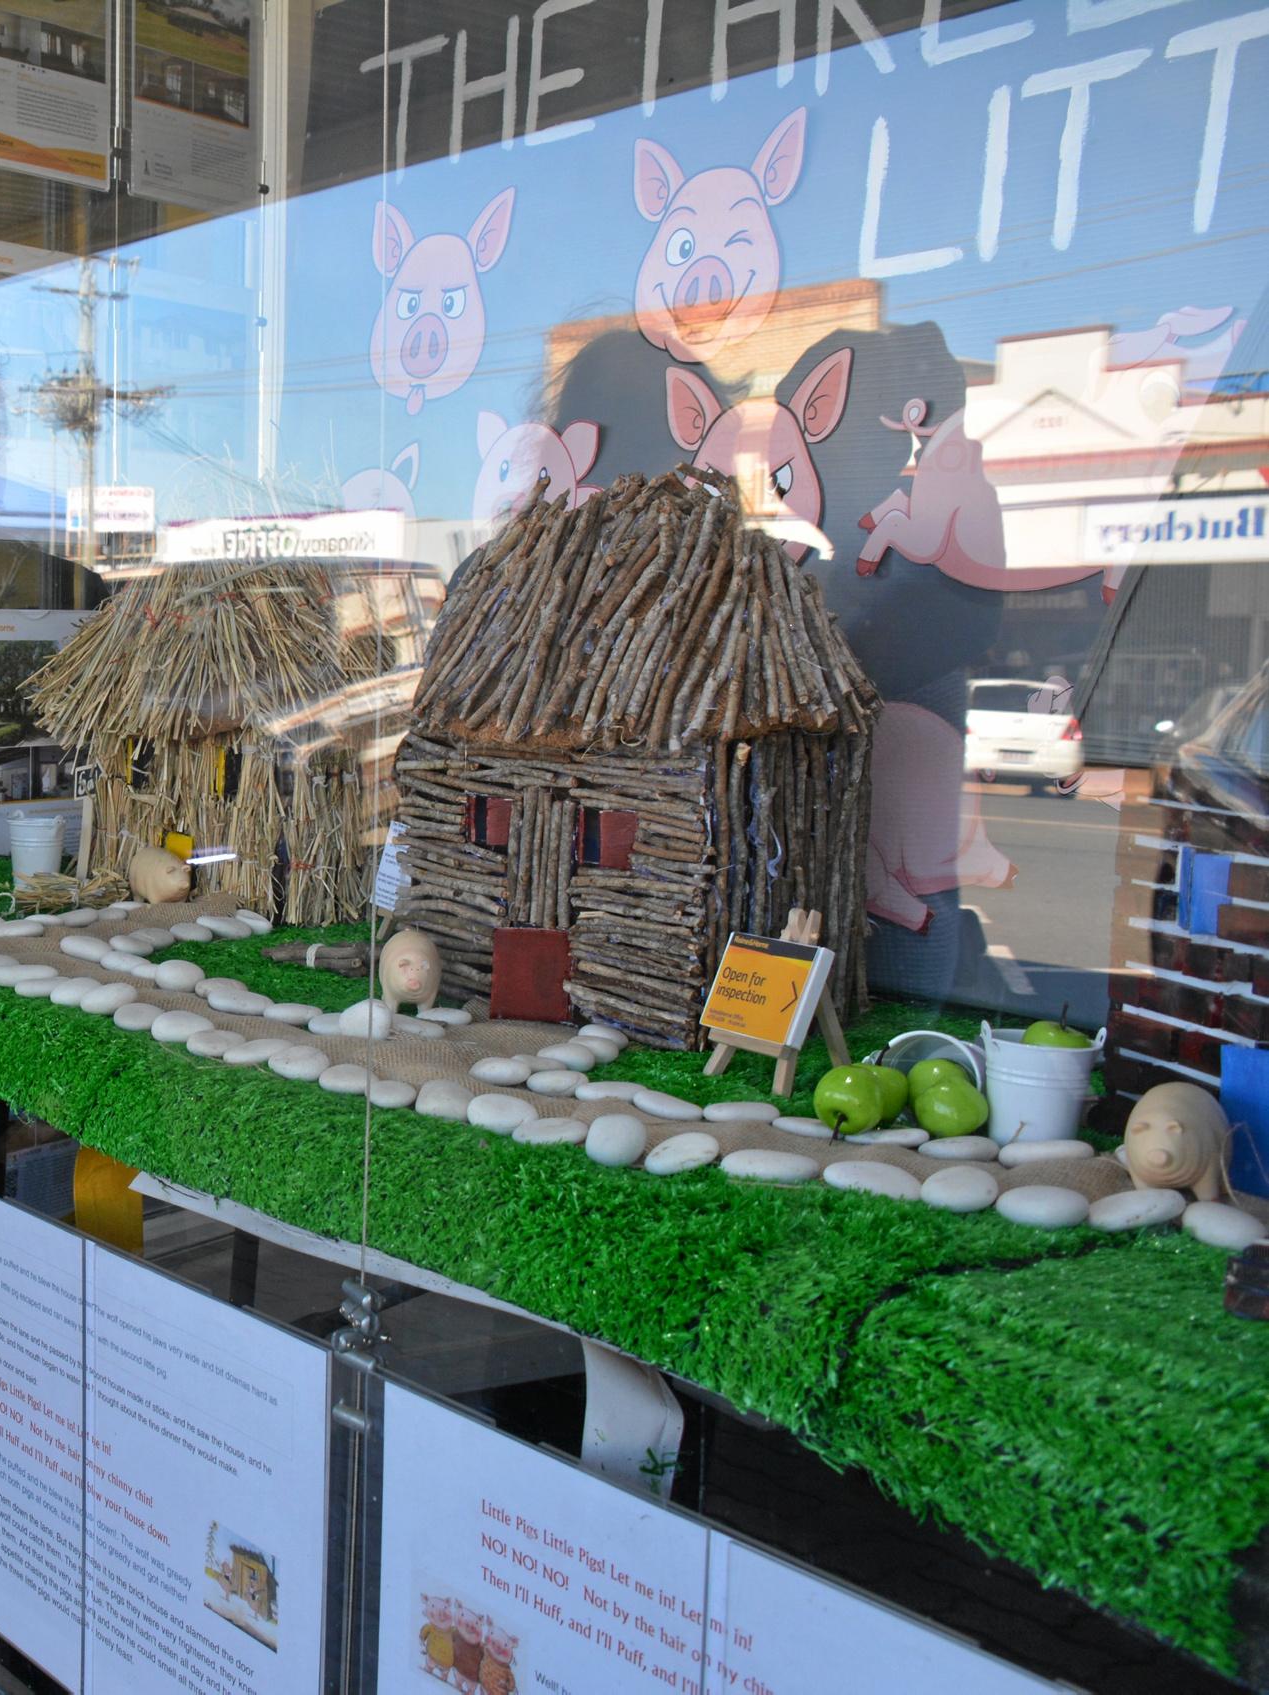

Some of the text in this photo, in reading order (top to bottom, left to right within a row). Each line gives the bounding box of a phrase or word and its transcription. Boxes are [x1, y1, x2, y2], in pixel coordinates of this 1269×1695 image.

[360, 0, 596, 185] THE
[716, 982, 766, 1005] inspection
[722, 966, 767, 988] Open for
[5, 1430, 19, 1448] Huff
[21, 1442, 32, 1456] and
[45, 1455, 58, 1472] Puff
[60, 1467, 72, 1482] and
[105, 1497, 121, 1514] your
[124, 1506, 145, 1530] house
[147, 1522, 170, 1547] down.
[10, 1408, 23, 1426] NO!
[30, 1421, 42, 1437] Not
[44, 1430, 52, 1446] by
[55, 1436, 65, 1452] the
[67, 1445, 80, 1462] hair
[107, 1473, 132, 1497] chinny
[135, 1490, 153, 1508] chin!
[481, 1566, 509, 1593] Then
[533, 1594, 563, 1624] Huff,
[568, 1617, 591, 1638] and
[617, 1641, 646, 1671] Puff,
[651, 1664, 676, 1686] and
[482, 1499, 510, 1526] Little
[516, 1516, 538, 1540] Pigs
[543, 1530, 574, 1558] Little
[579, 1548, 605, 1574] Pigs!
[611, 1565, 630, 1587] Let
[634, 1581, 653, 1599] me
[658, 1590, 675, 1611] in!
[681, 1602, 702, 1625] Let
[733, 1629, 752, 1652] in!
[482, 1533, 507, 1558] NO!
[512, 1548, 537, 1573] NO!
[542, 1564, 569, 1590] NO!
[583, 1585, 608, 1611] Not
[613, 1602, 629, 1626] by
[635, 1614, 655, 1637] the
[660, 1628, 686, 1654] hair
[691, 1648, 710, 1668] on
[534, 1670, 559, 1692] Well!
